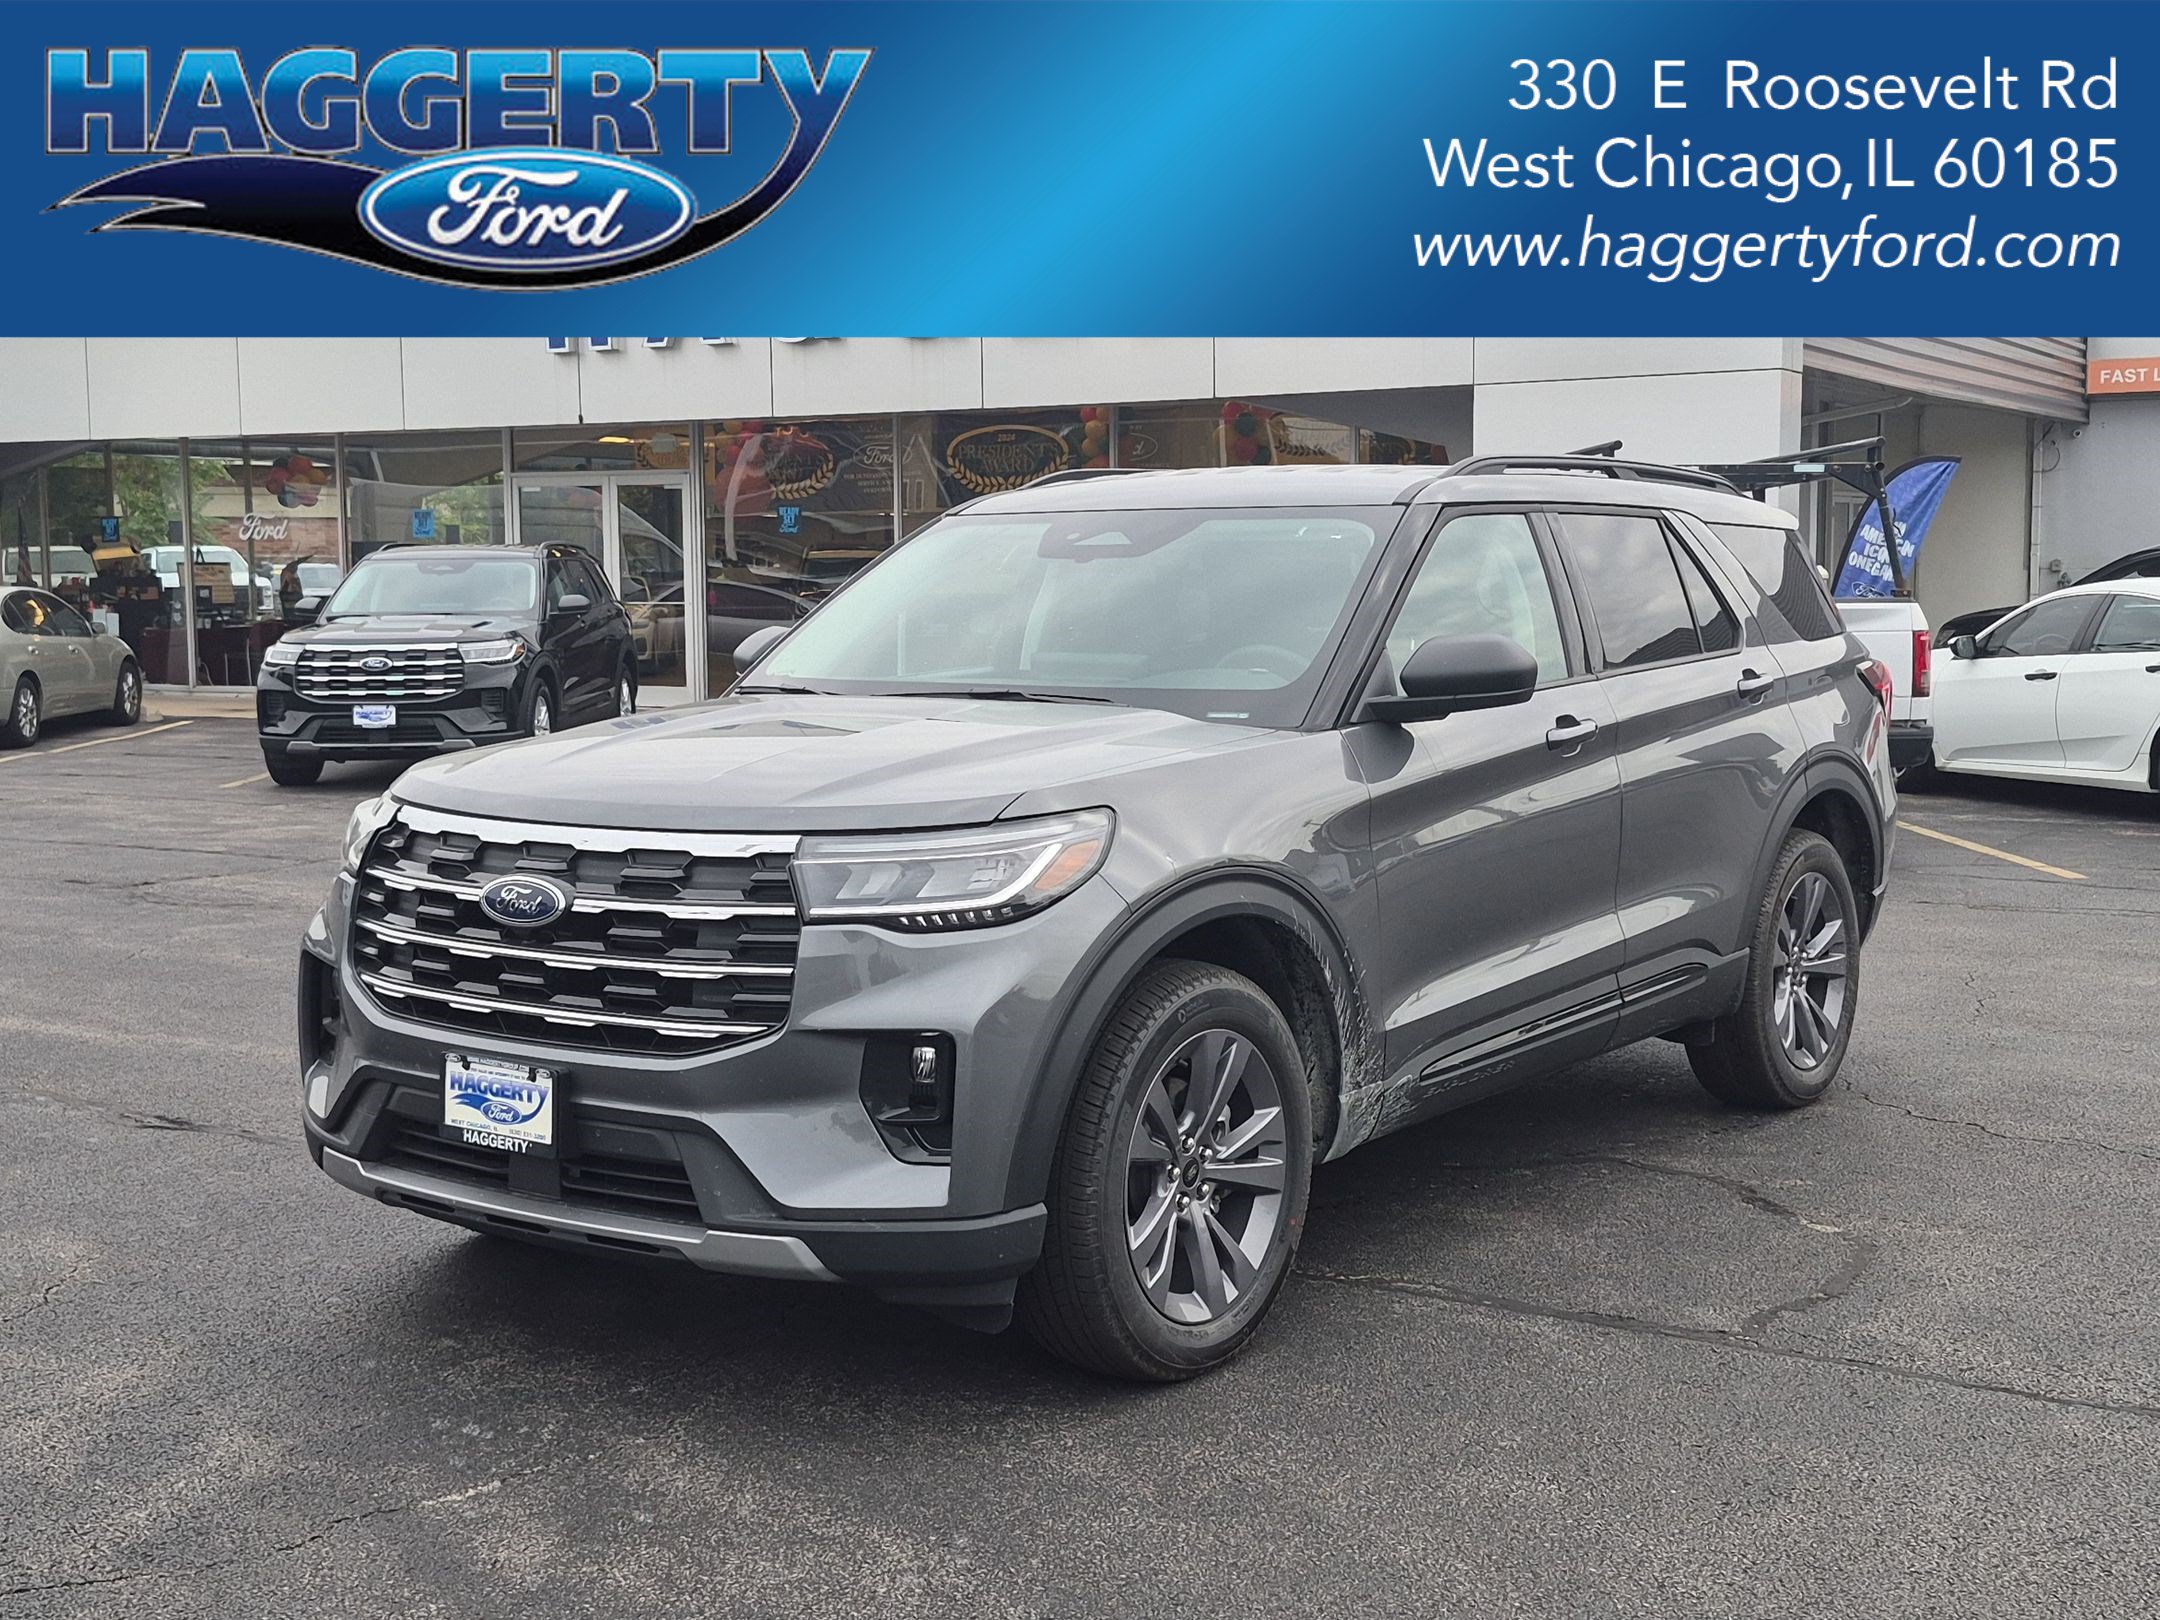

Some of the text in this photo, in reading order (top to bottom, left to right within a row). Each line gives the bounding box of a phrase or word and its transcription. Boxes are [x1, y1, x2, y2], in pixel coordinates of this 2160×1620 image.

[2100, 368, 2149, 384] FAST
[239, 512, 288, 541] Ford
[495, 885, 543, 914] Ford
[450, 1070, 551, 1104] HAGGERTY
[488, 1103, 514, 1122] Ford
[462, 1129, 529, 1154] HAGGERTY
